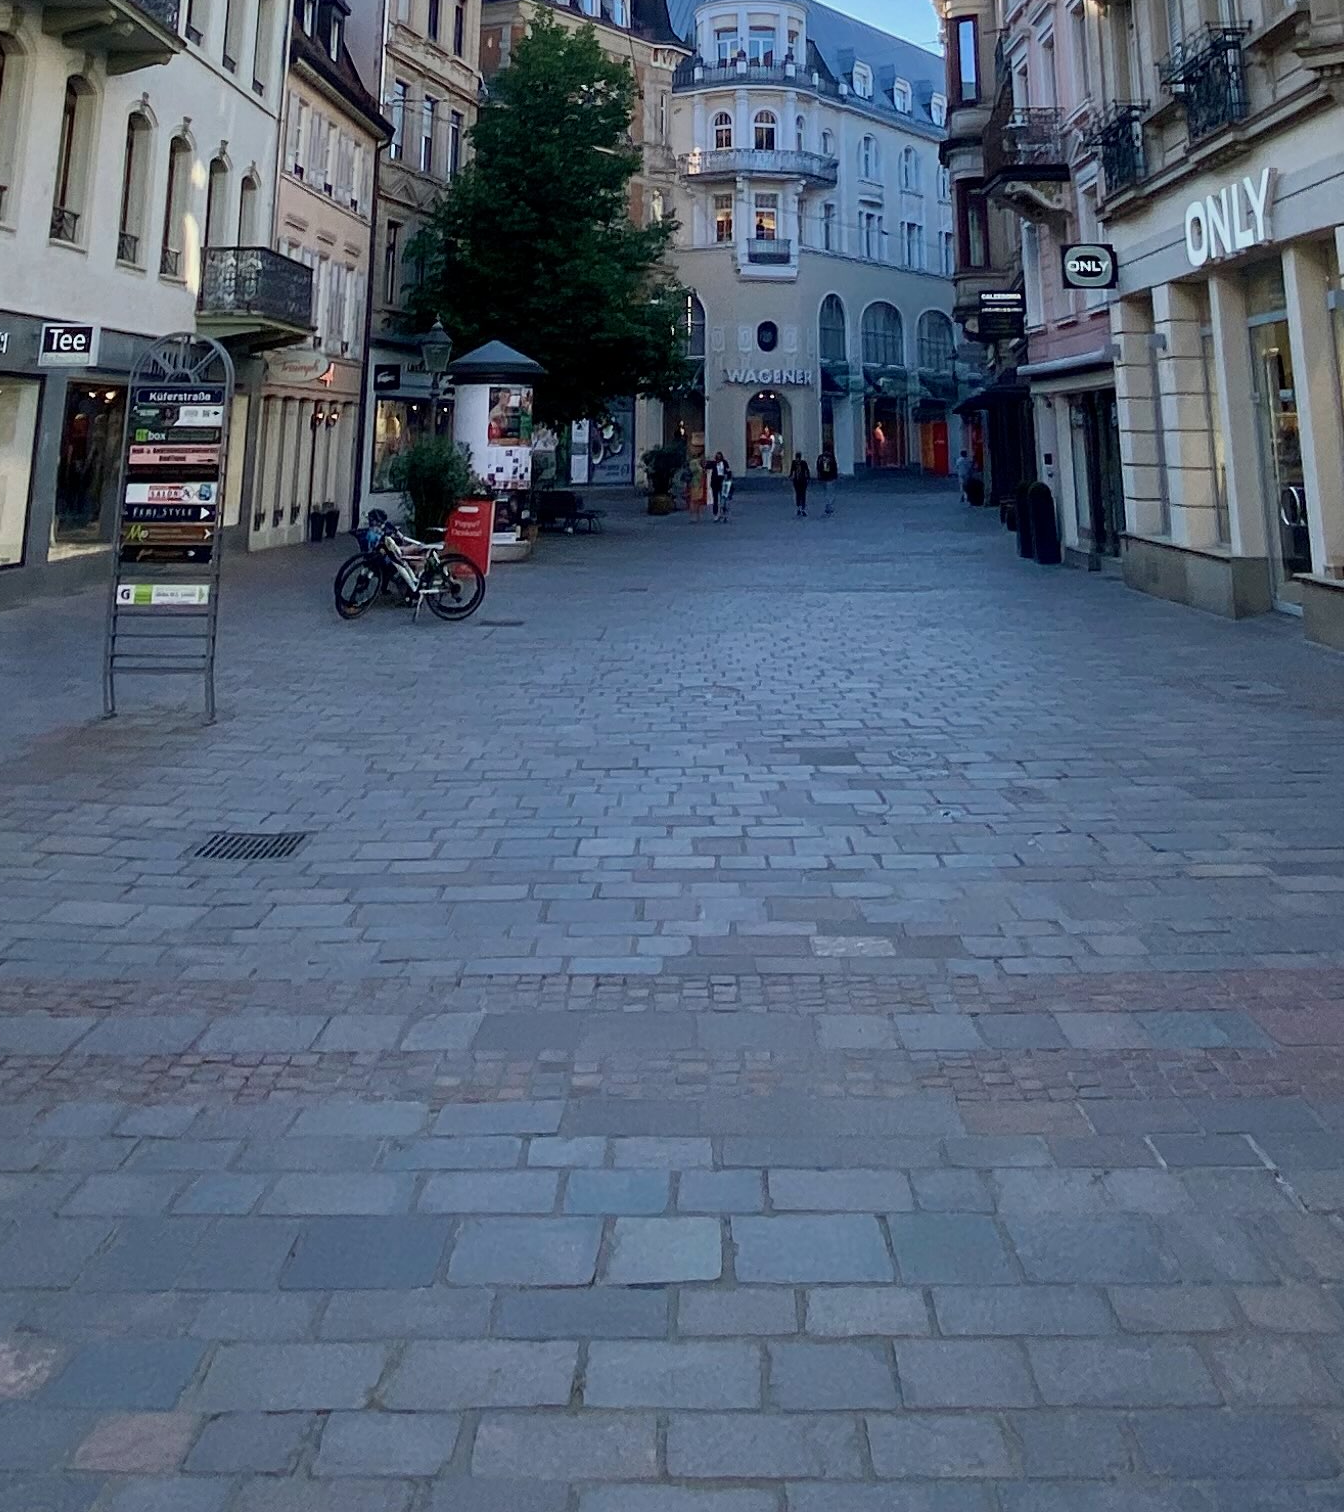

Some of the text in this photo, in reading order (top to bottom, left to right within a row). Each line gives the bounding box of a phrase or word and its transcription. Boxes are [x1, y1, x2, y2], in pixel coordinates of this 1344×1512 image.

[1185, 167, 1270, 267] ONLY
[1067, 260, 1108, 272] ONLY
[49, 328, 86, 351] Tee
[724, 368, 812, 385] WAGENER
